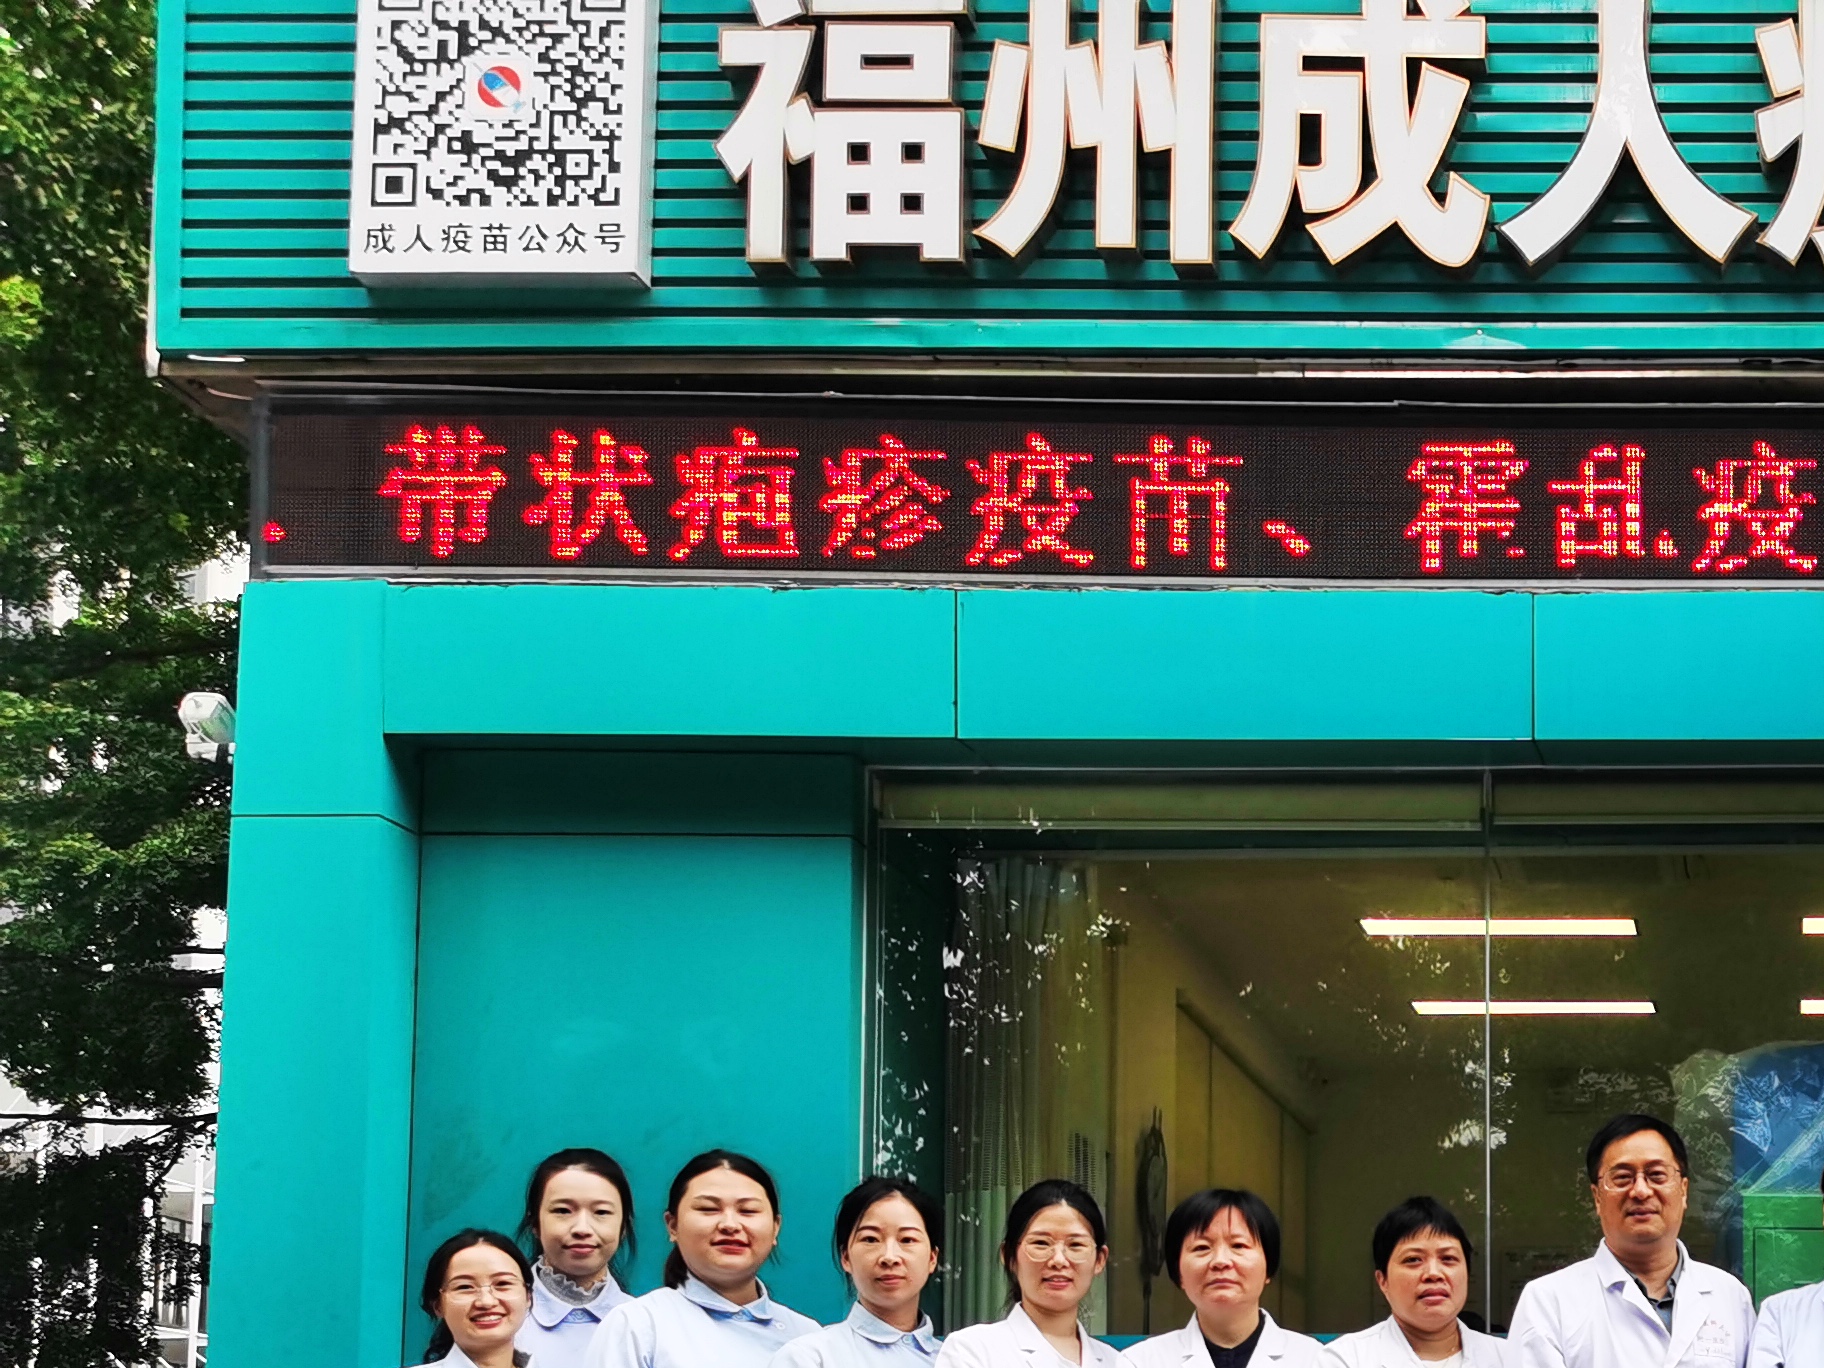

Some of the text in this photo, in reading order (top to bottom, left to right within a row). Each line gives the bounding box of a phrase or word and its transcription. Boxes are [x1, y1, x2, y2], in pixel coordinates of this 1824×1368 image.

[363, 222, 627, 254] 成人疫苗公众号
